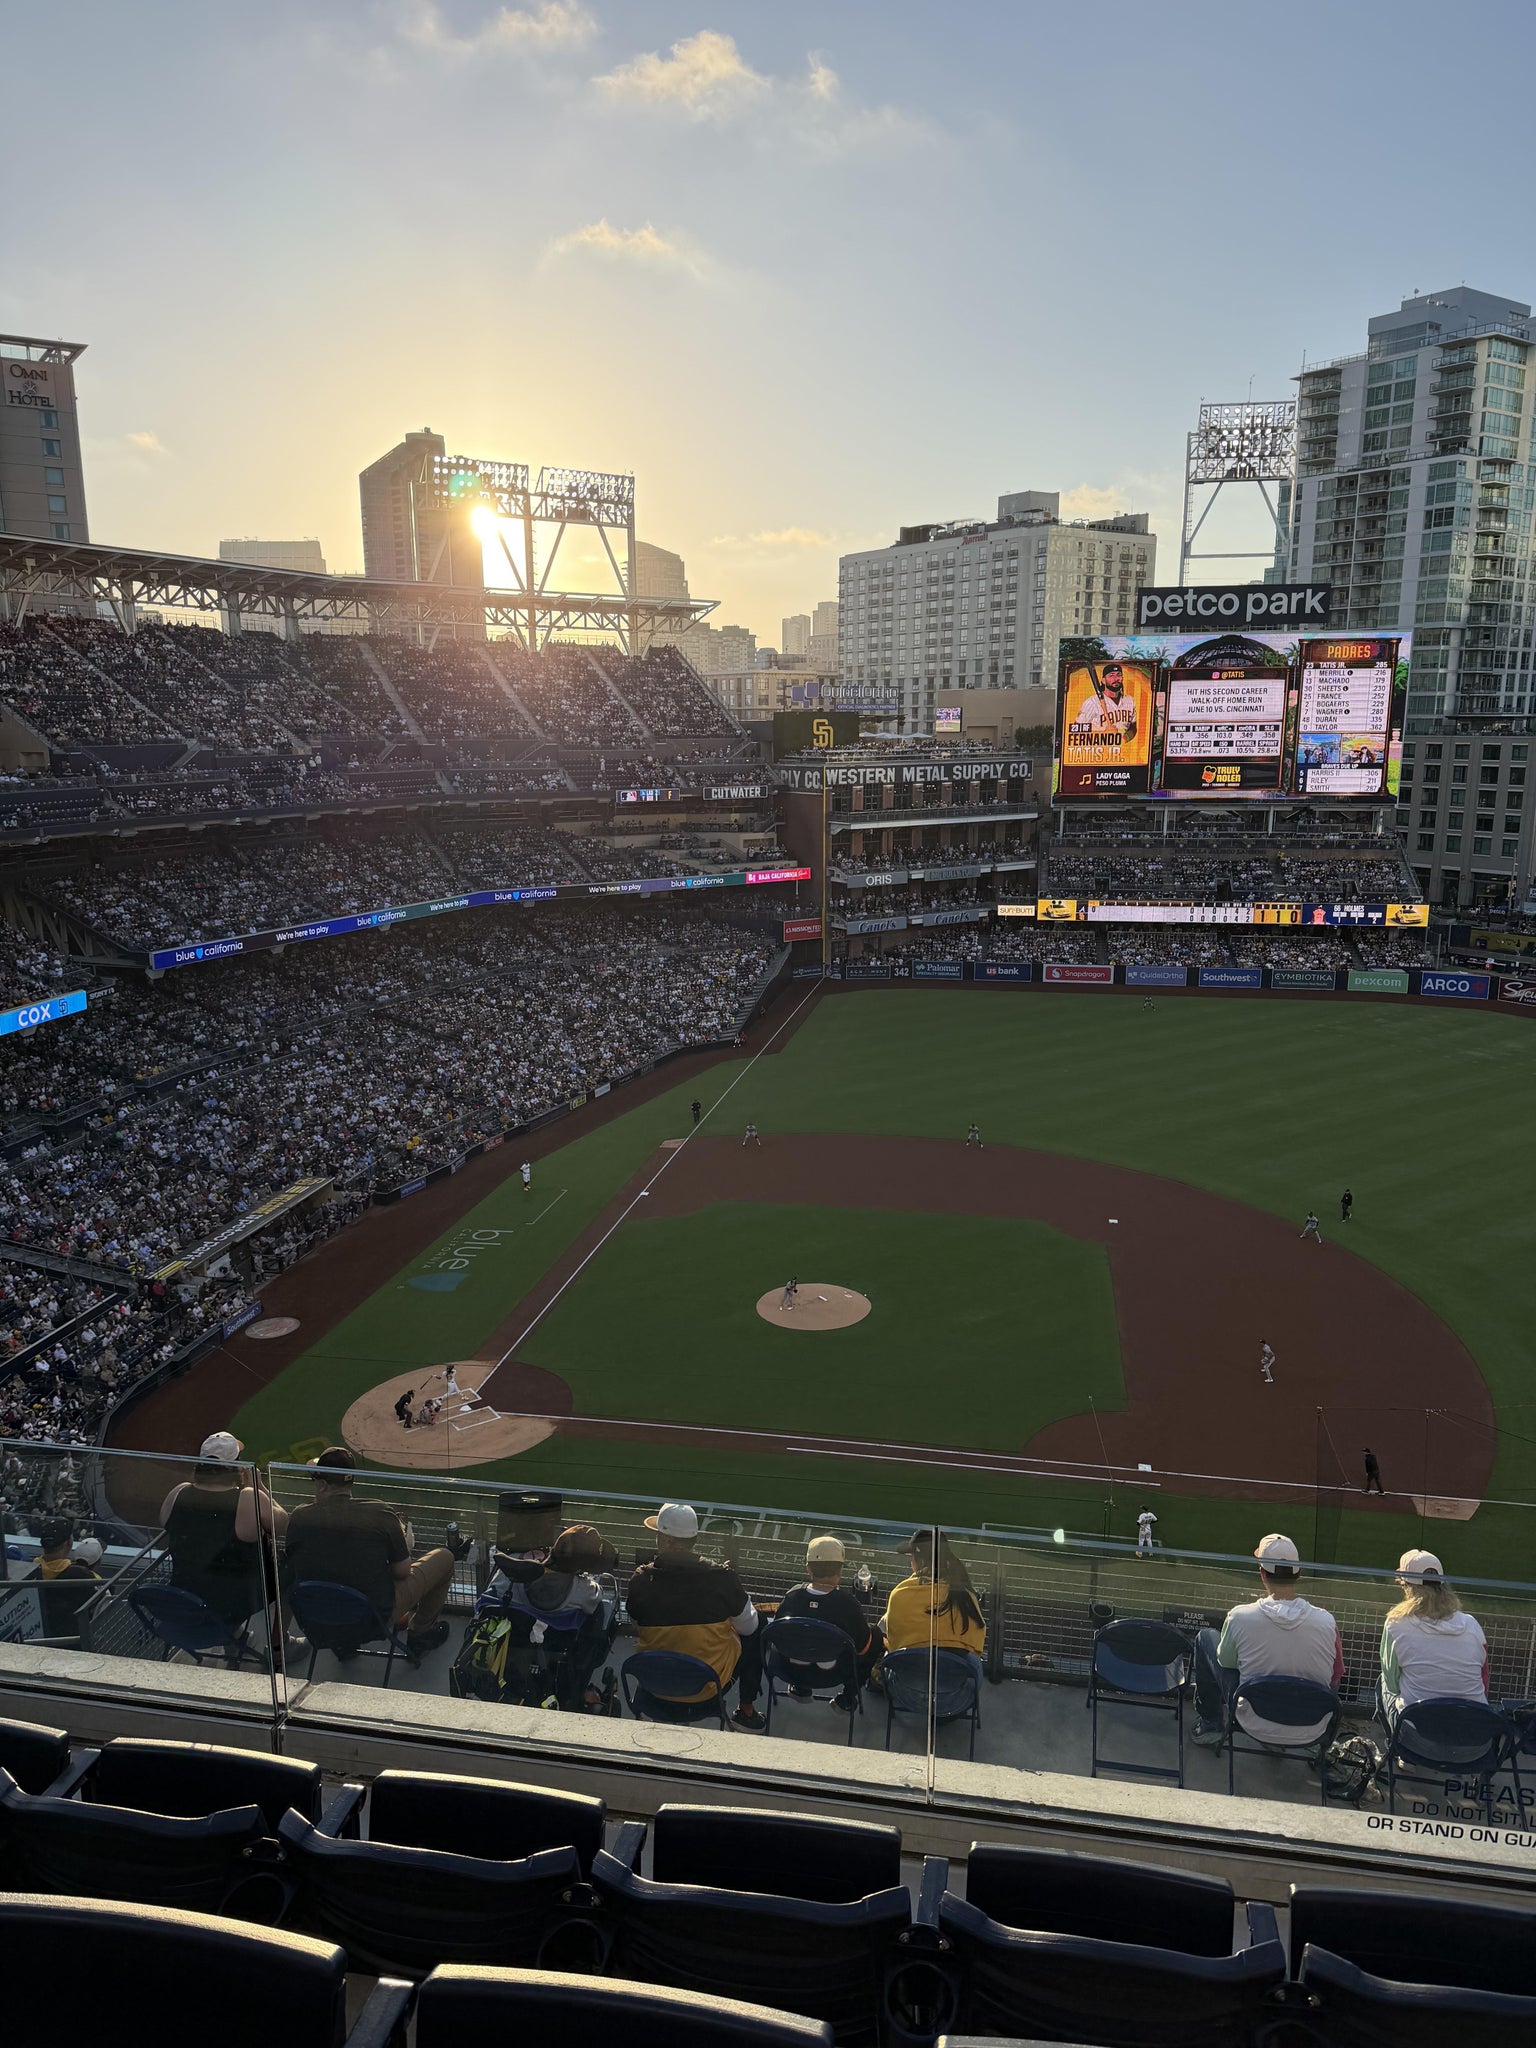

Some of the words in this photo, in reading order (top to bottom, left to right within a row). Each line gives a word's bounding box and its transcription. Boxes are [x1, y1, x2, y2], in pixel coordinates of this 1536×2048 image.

[8, 390, 54, 408] HOTEL
[1140, 588, 1240, 624] petco
[1246, 588, 1326, 621] park
[1327, 645, 1371, 658] PADRES
[821, 684, 900, 700] QuidelOrtho
[1068, 733, 1122, 746] FERNANDO
[1068, 747, 1105, 762] TATIS
[1106, 747, 1125, 762] JR.
[826, 768, 896, 786] WESTERN
[902, 765, 948, 782] METAL
[952, 764, 1005, 780] SUPPLY
[1010, 762, 1032, 778] CO.
[711, 787, 761, 799] CUTWATER
[693, 877, 724, 886] california
[866, 874, 892, 886] ORIS
[495, 892, 512, 900] blue
[520, 889, 557, 899] california
[628, 882, 641, 891] play
[357, 918, 371, 926] blue
[378, 910, 406, 922] california
[459, 898, 469, 907] play
[936, 912, 970, 924] Canel's
[1260, 910, 1264, 922] 1
[1276, 911, 1280, 922] 1
[1291, 911, 1298, 923] 0
[859, 919, 897, 932] Canel's
[832, 931, 845, 940] 330
[176, 952, 195, 962] blue
[204, 941, 243, 956] california
[276, 933, 293, 942] We're
[316, 926, 329, 936] play
[894, 967, 909, 976] 342
[926, 964, 960, 972] Palomar
[1064, 970, 1105, 979] Snapdragon
[1140, 971, 1184, 980] QuidelOrtho
[1203, 973, 1250, 982] Southwest
[1424, 978, 1470, 992] ARCO
[18, 1003, 51, 1027] COX
[438, 1229, 514, 1270] blue
[1184, 1612, 1204, 1620] PLEASE
[1412, 1801, 1439, 1815] DO
[1446, 1805, 1485, 1821] NOT
[1492, 1811, 1522, 1828] SIT,
[1367, 1816, 1393, 1830] OR
[1400, 1820, 1464, 1839] STAND
[1470, 1828, 1498, 1843] ON
